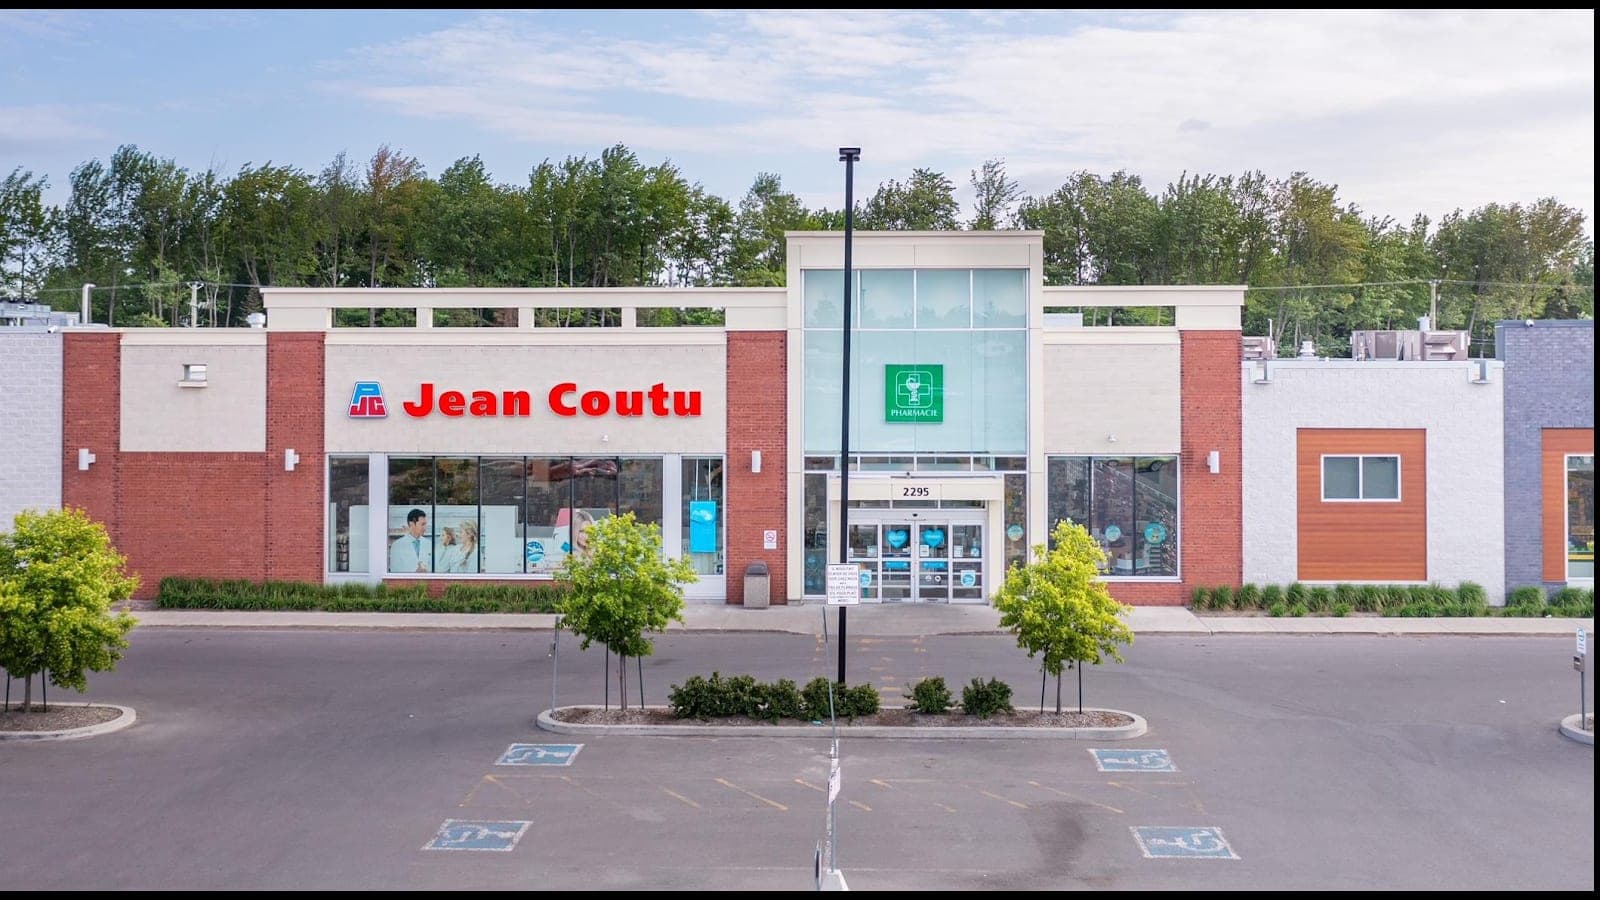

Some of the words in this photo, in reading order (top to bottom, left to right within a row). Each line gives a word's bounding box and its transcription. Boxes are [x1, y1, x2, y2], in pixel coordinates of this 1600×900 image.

[403, 383, 531, 418] Jean
[548, 382, 702, 417] Coutu
[891, 409, 938, 417] PHARMACIE
[903, 487, 929, 497] 2295
